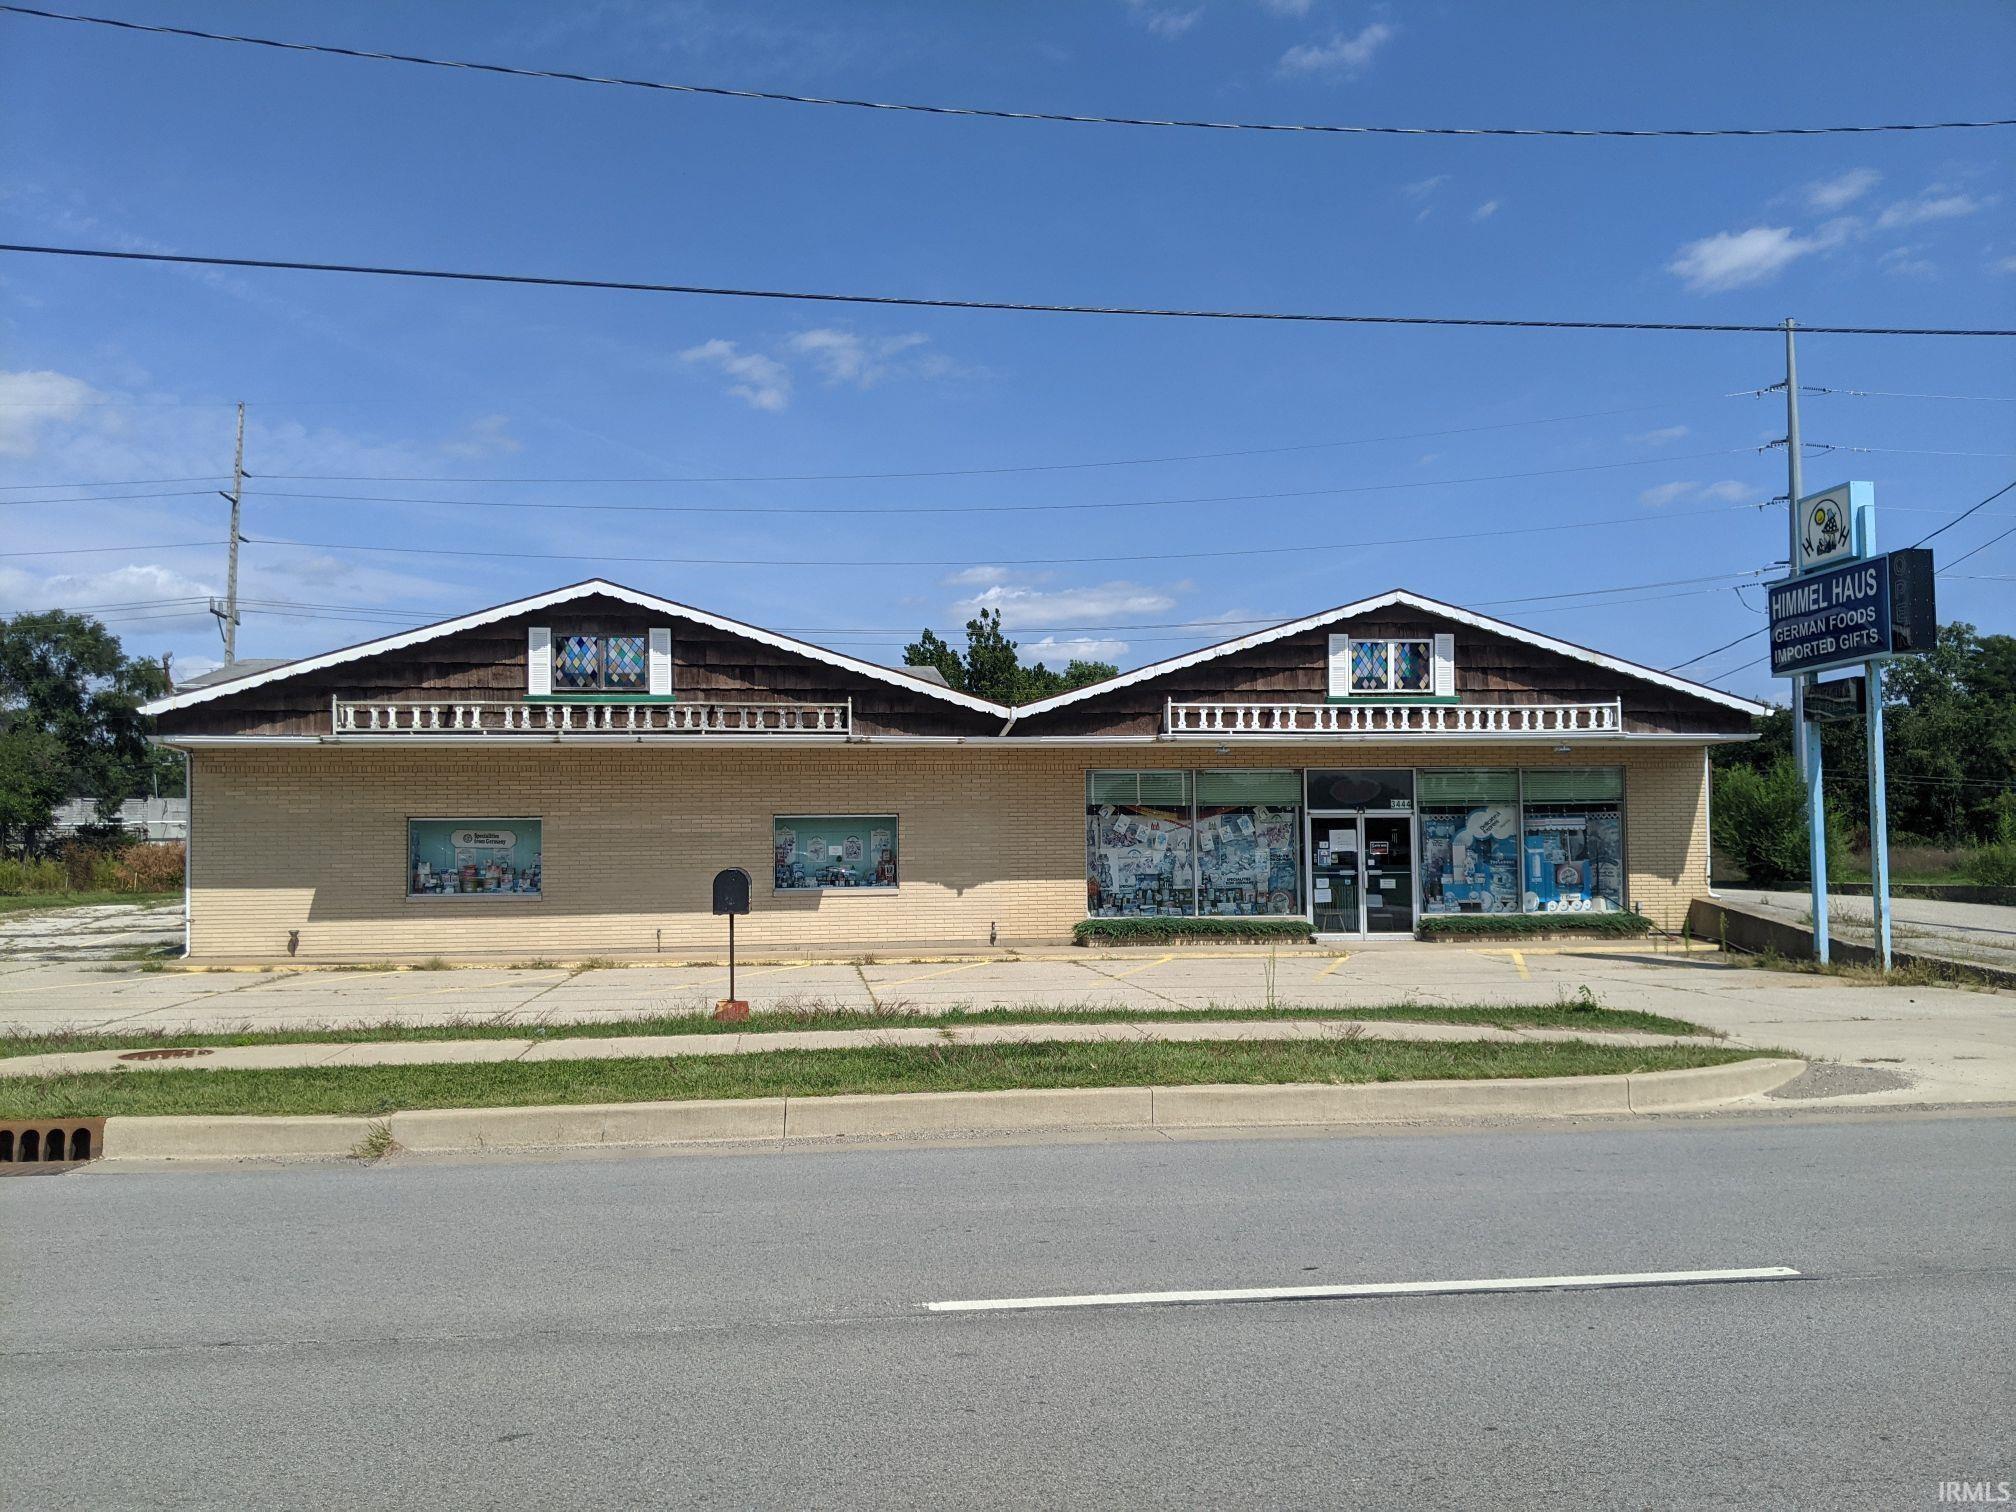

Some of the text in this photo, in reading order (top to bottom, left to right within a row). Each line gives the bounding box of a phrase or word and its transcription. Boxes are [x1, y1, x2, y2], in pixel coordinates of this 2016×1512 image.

[1802, 526, 1850, 557] H H
[1772, 568, 1878, 620] HIMMEL HAUS
[1775, 606, 1876, 643] GERMAN FOODS
[1774, 628, 1879, 663] IMPORTED GIFTS
[1391, 800, 1411, 808] 3444
